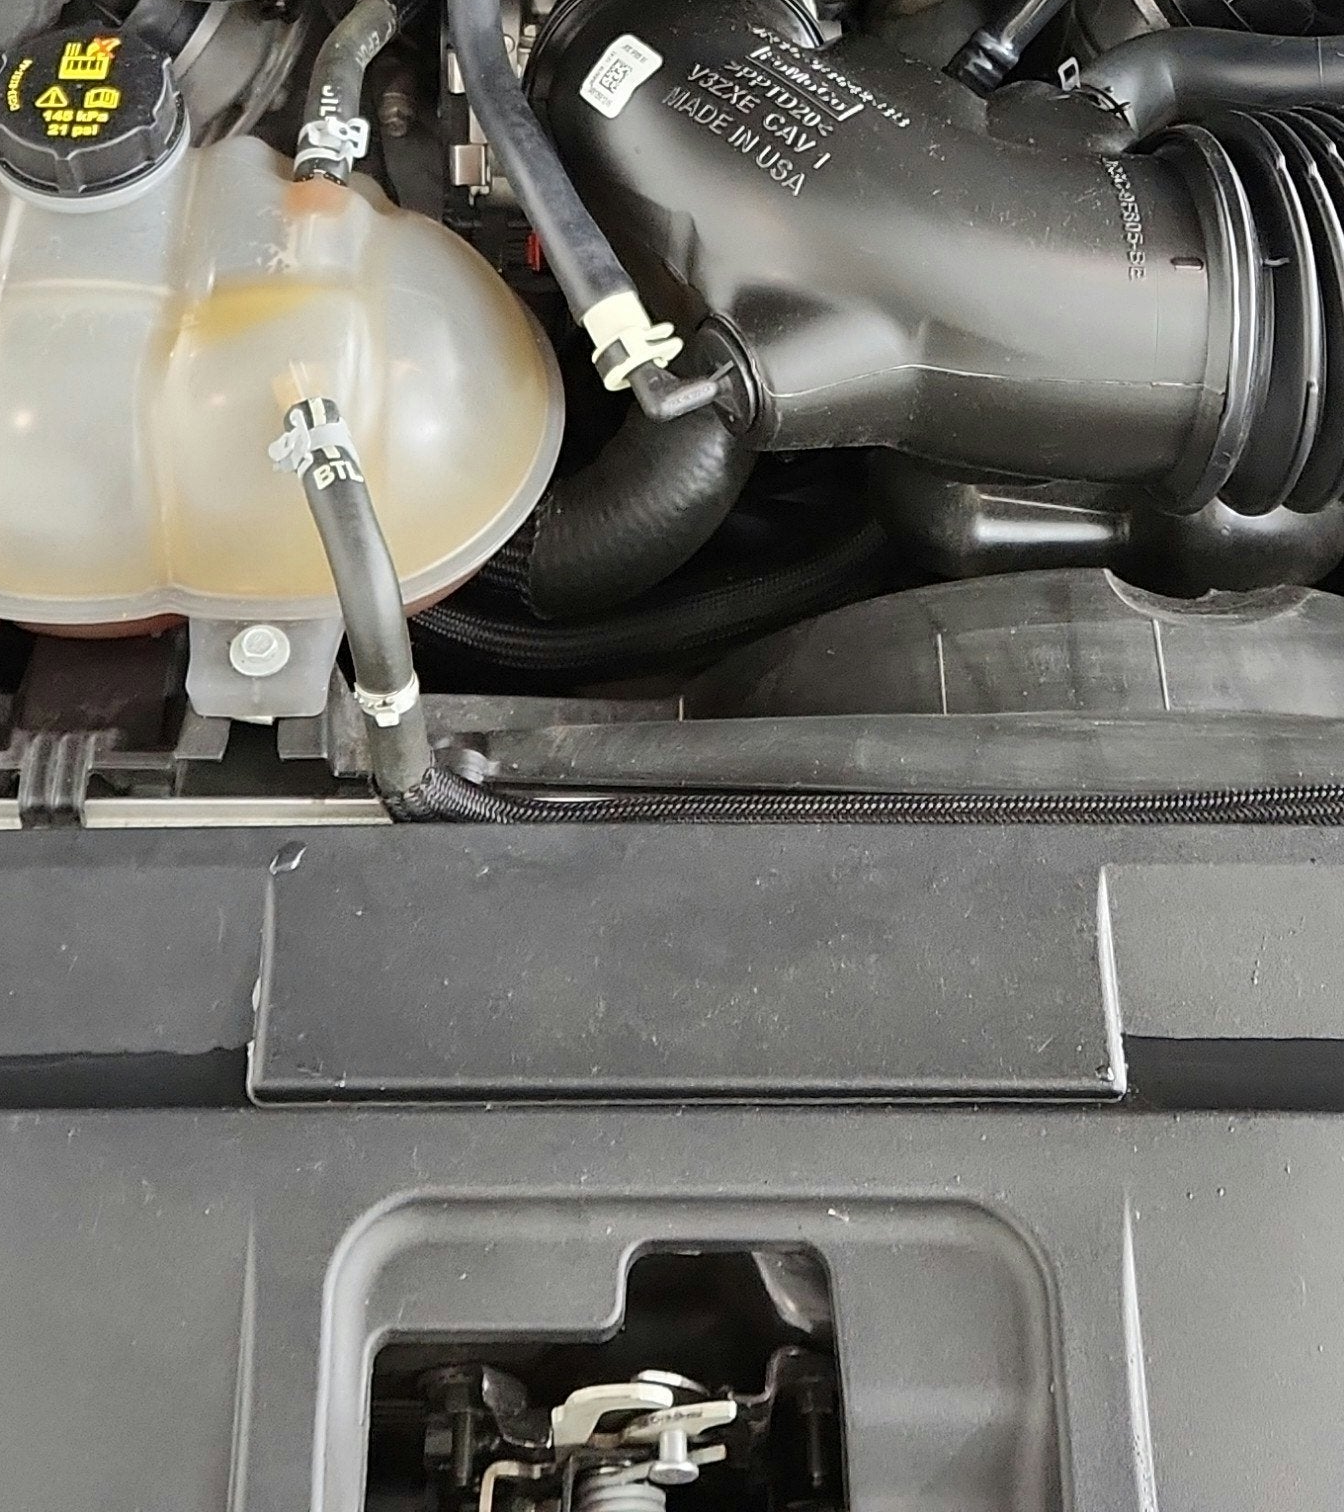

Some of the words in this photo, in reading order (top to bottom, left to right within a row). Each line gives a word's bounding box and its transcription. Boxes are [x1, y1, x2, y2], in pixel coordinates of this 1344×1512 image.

[42, 109, 74, 123] 145
[75, 109, 110, 124] kPa
[46, 123, 70, 137] 21
[71, 123, 100, 139] psi
[662, 86, 734, 136] MADE
[727, 125, 760, 154] IN
[755, 144, 805, 197] USA
[763, 112, 817, 153] CAV
[312, 459, 365, 490] BTL
